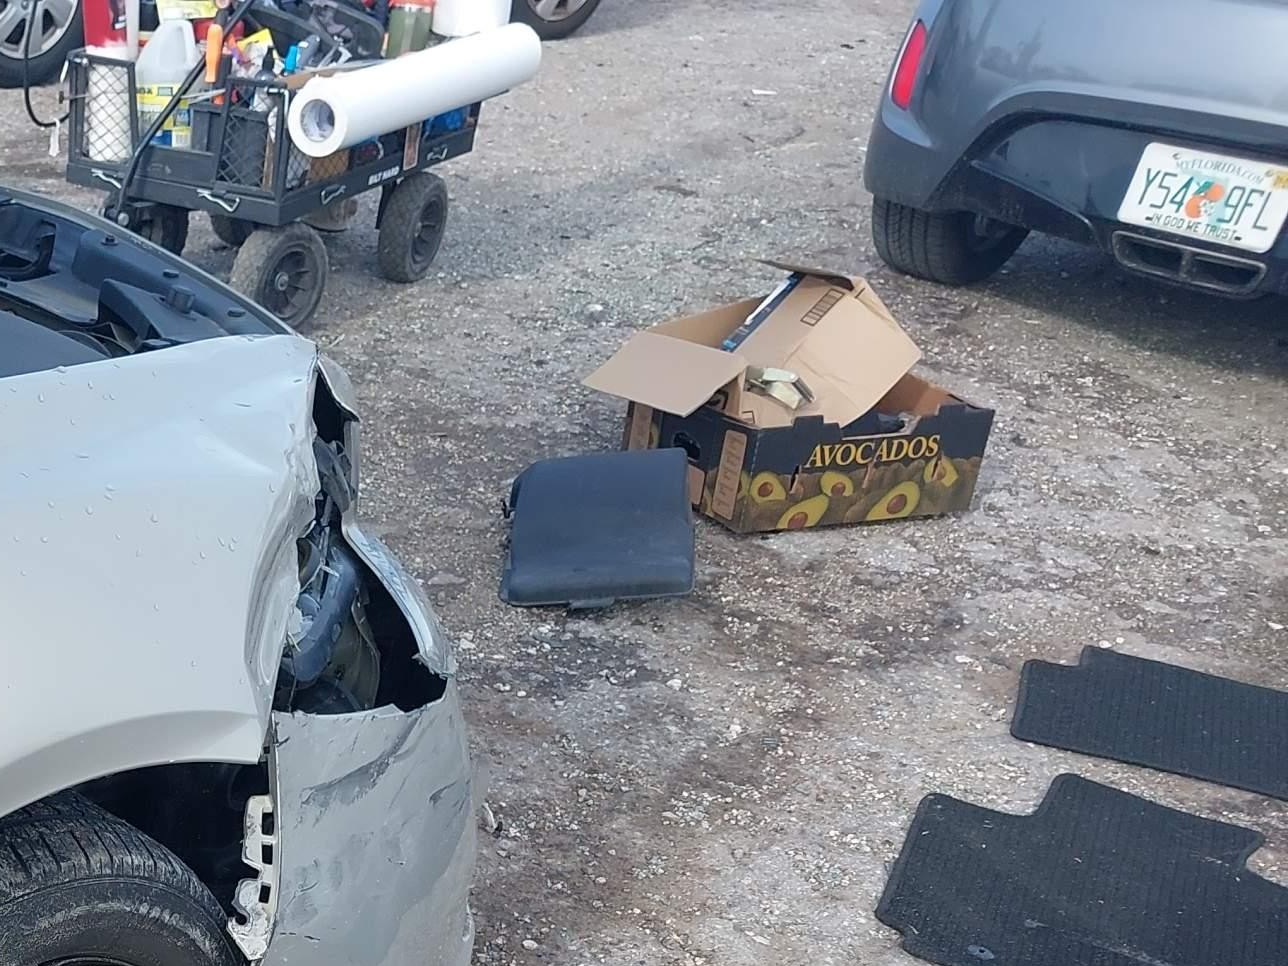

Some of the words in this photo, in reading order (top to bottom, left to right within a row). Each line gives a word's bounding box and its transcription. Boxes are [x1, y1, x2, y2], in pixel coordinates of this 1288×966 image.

[1138, 168, 1194, 214] Y54
[1216, 185, 1273, 231] 9FL
[1152, 213, 1162, 224] IN
[1162, 215, 1183, 229] GOD
[1186, 221, 1200, 233] WE
[1203, 223, 1236, 241] TRUST
[803, 434, 941, 468] AVOCADOS
